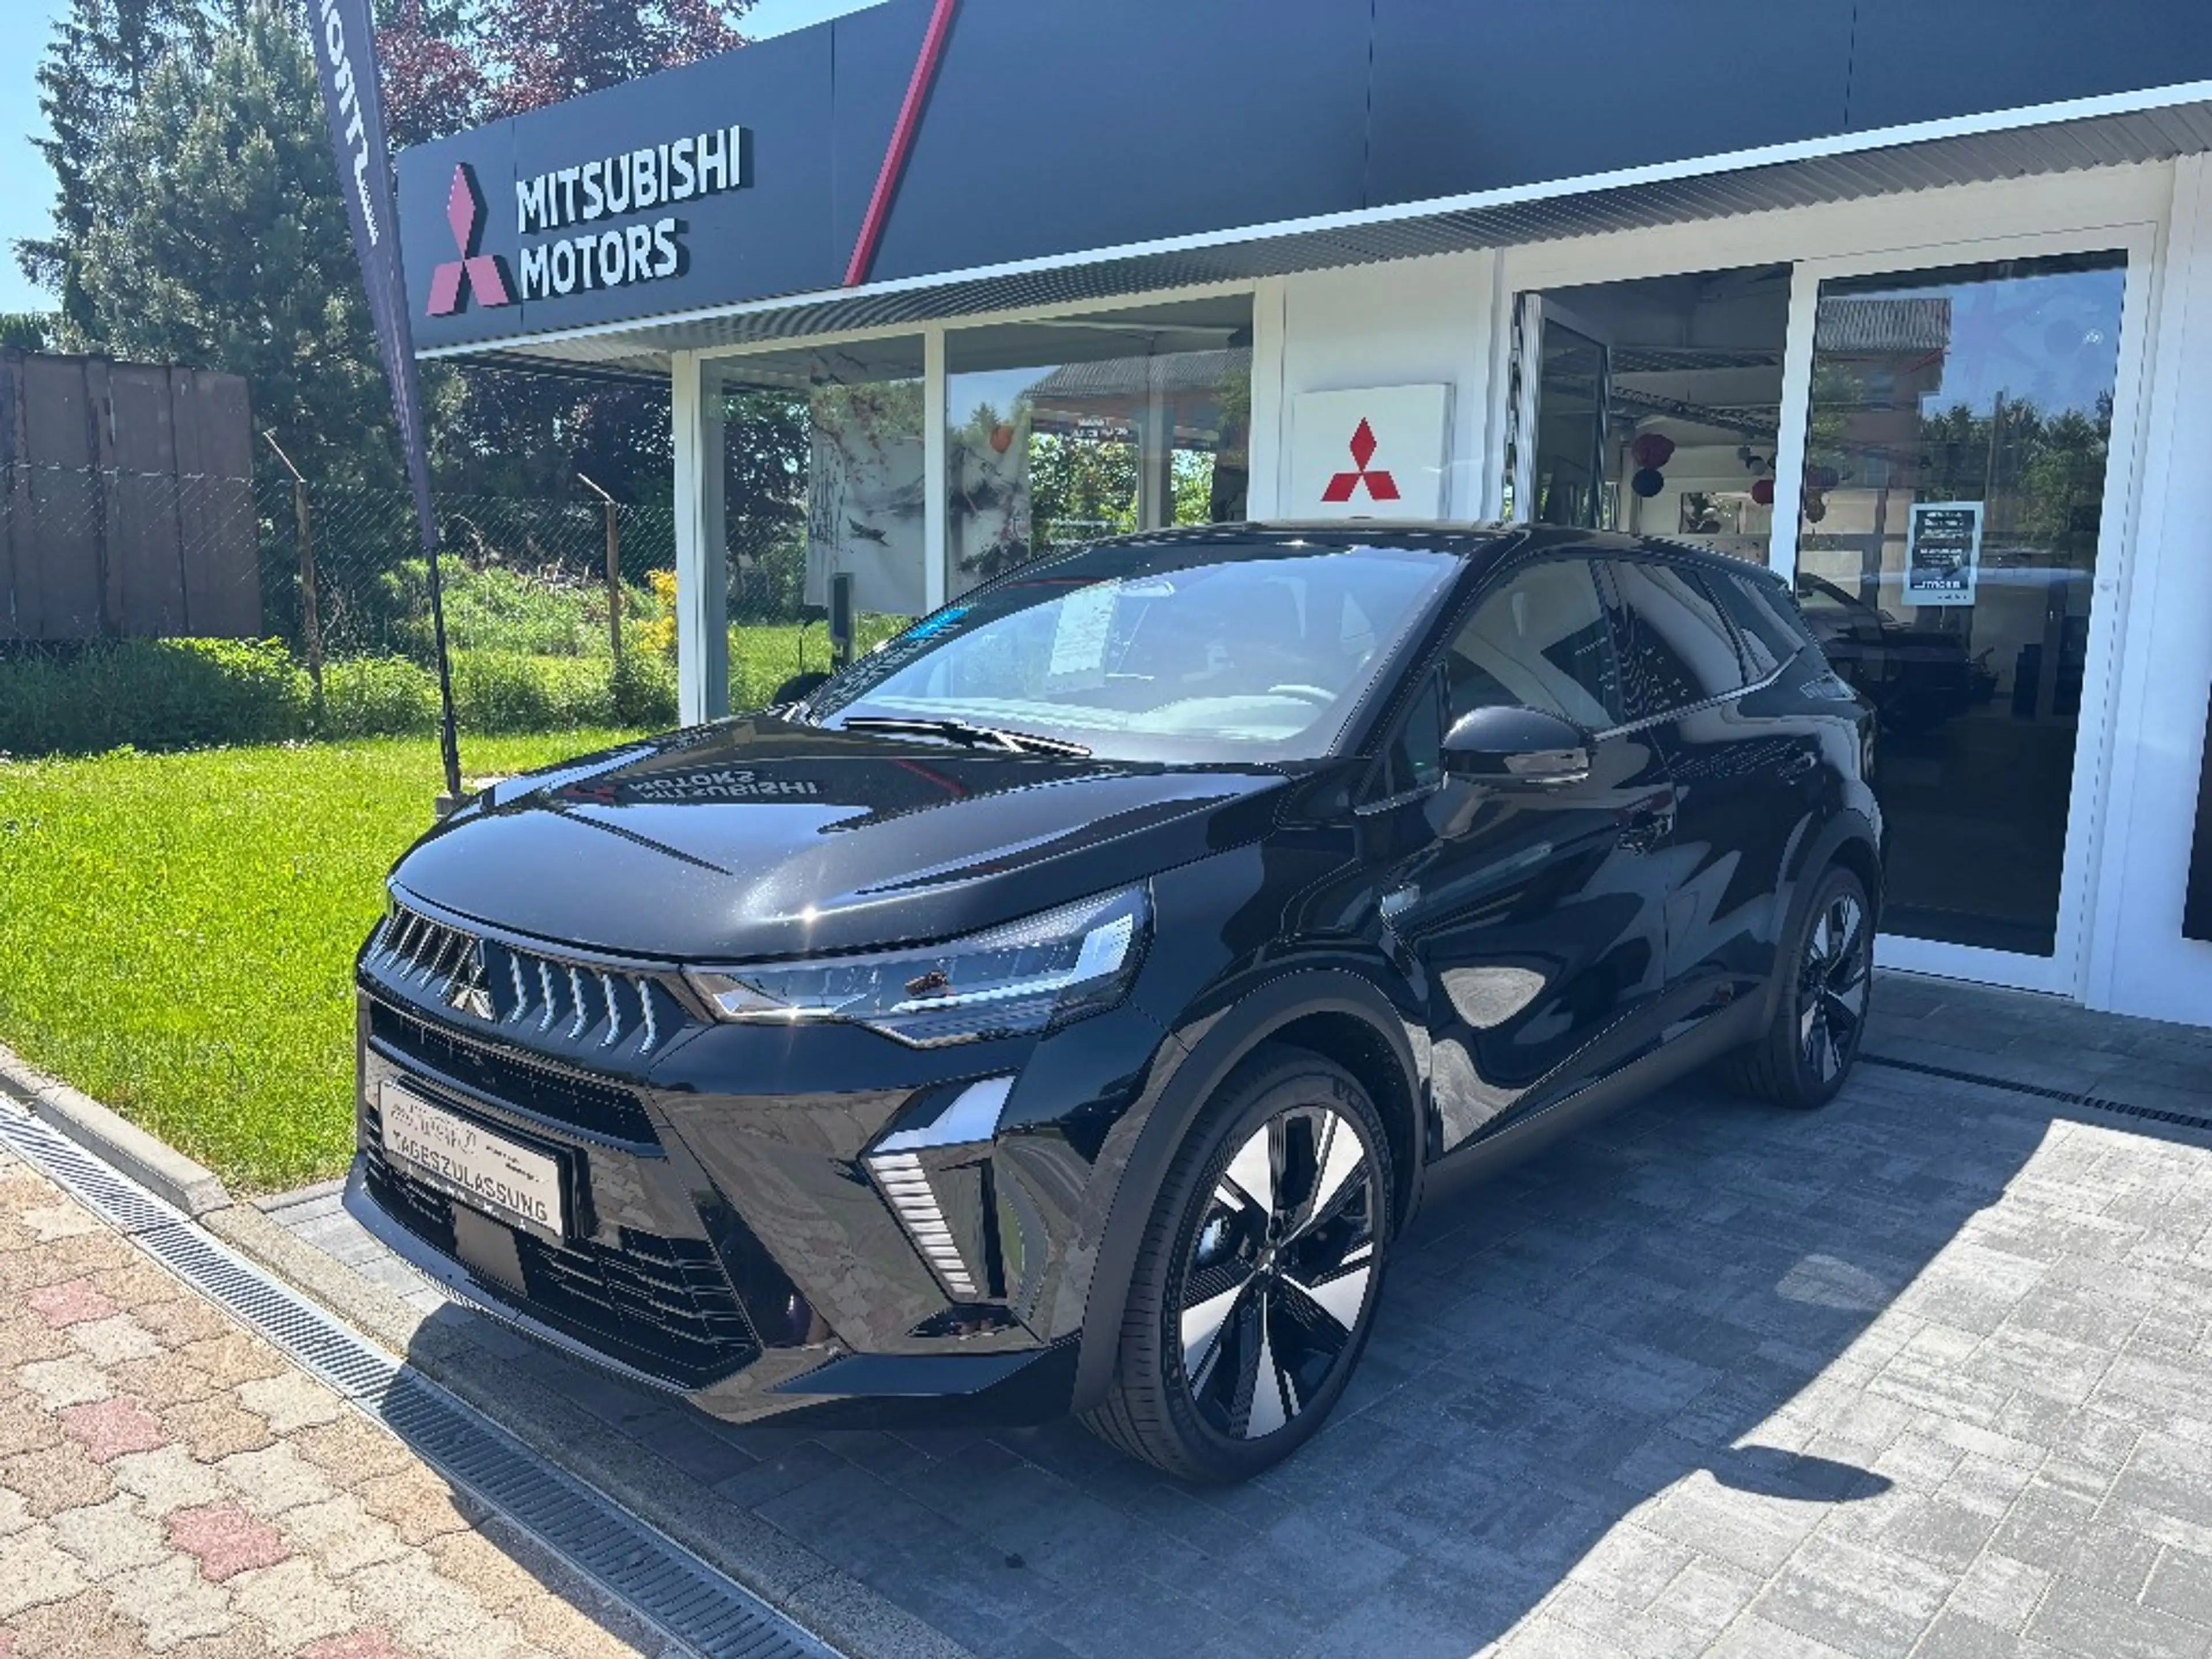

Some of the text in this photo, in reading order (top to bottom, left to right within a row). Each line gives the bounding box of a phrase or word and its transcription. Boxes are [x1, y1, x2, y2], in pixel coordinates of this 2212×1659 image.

[516, 124, 741, 234] MITSUBISHI
[520, 217, 678, 300] MOTORS
[392, 1129, 548, 1222] TAGESZULASSUNG
